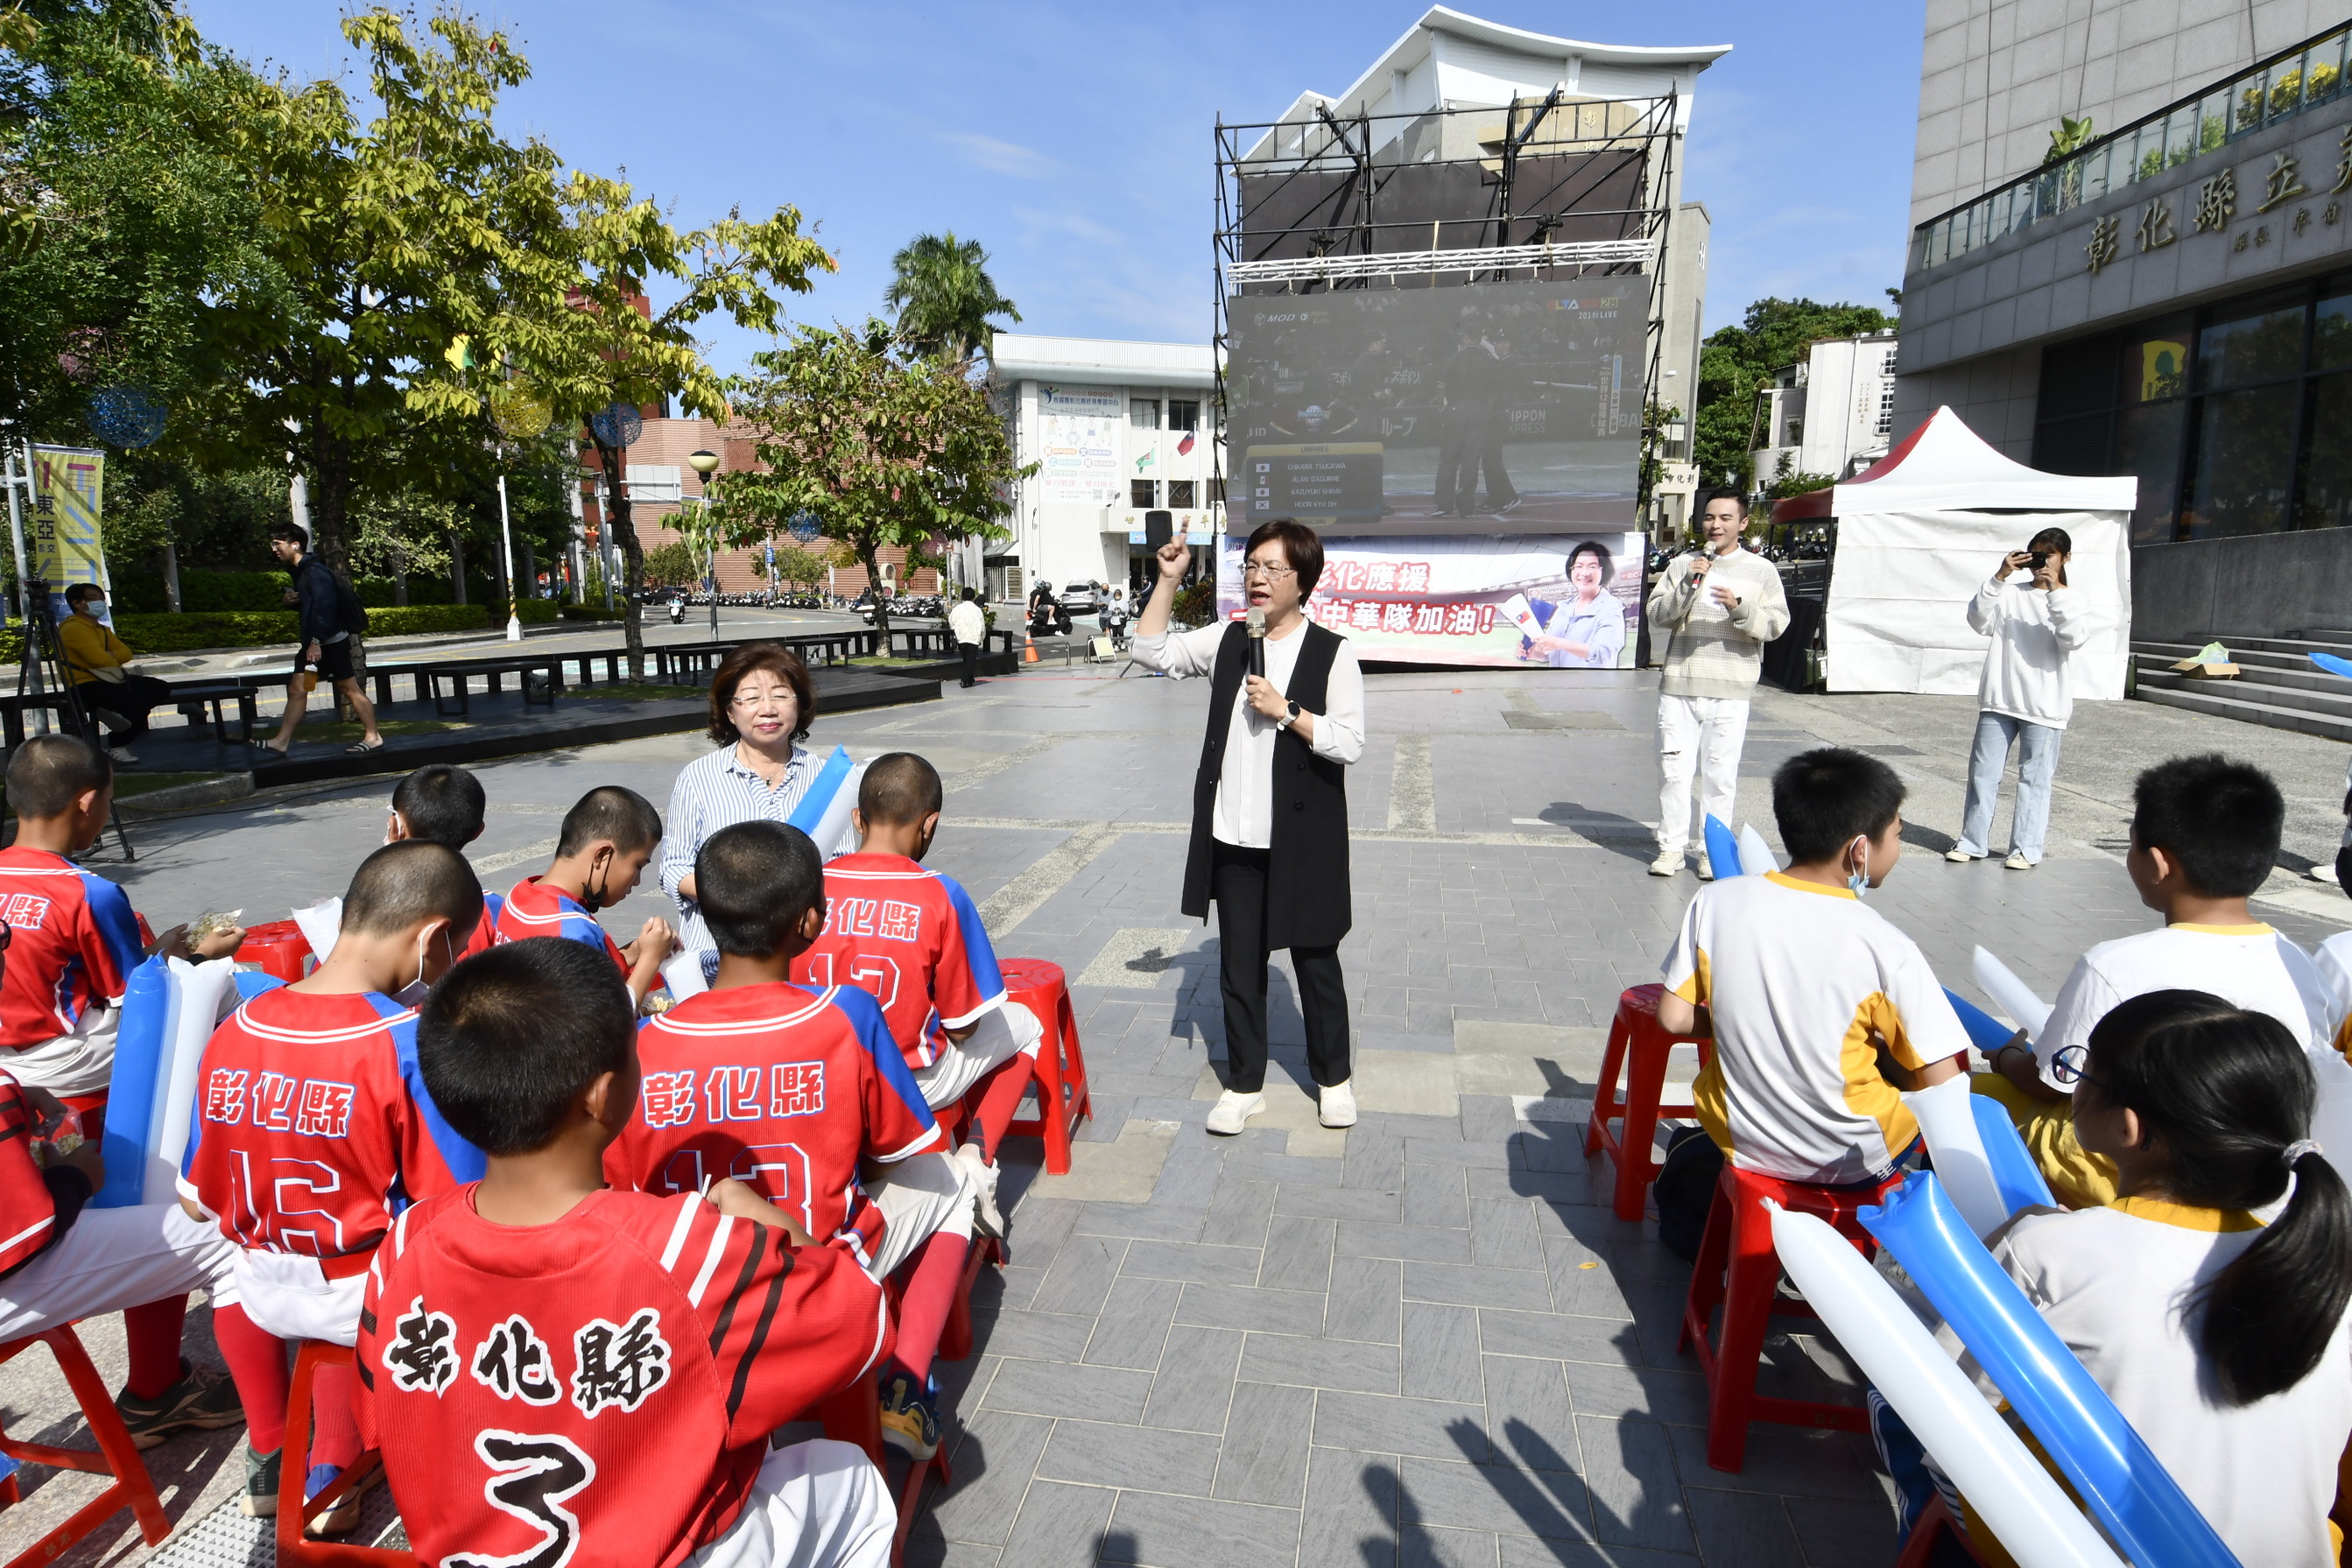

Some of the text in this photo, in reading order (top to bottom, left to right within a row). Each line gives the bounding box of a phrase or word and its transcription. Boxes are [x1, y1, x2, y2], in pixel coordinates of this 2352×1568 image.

[36, 494, 55, 539] 東亞
[0, 893, 51, 930] 縣
[204, 1066, 356, 1139] 彰化縣
[642, 1059, 826, 1129] 彰化縣
[382, 1294, 673, 1420] 彰化縣
[439, 1428, 598, 1568] 3
